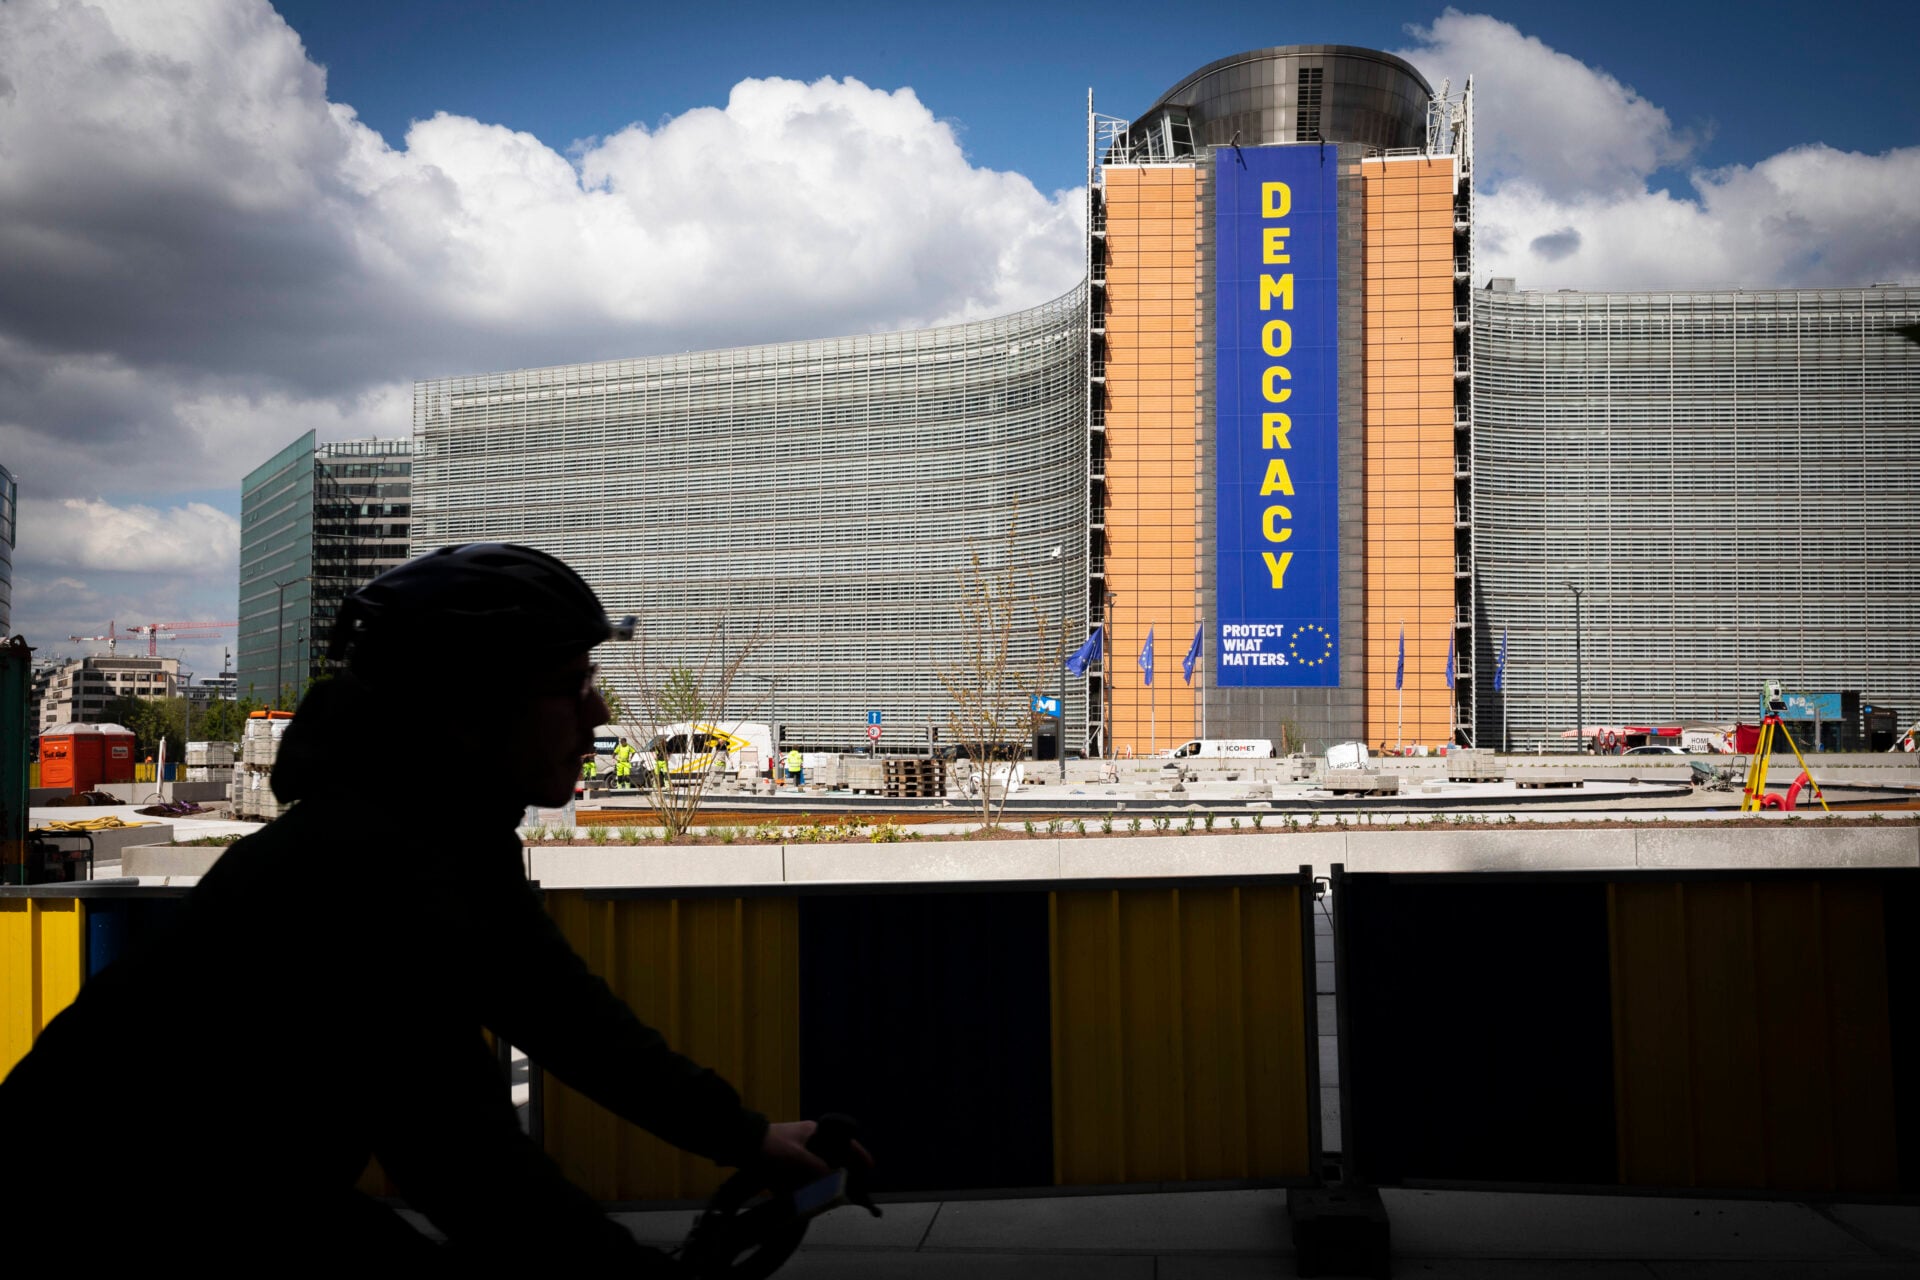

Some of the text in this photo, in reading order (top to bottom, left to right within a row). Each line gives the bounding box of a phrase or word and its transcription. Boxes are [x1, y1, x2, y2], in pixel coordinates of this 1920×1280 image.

[1259, 181, 1295, 589] DEMOCRACY
[1222, 624, 1284, 637] PROTECT
[1222, 639, 1263, 652] WHAT
[1222, 653, 1289, 666] MATTERS.
